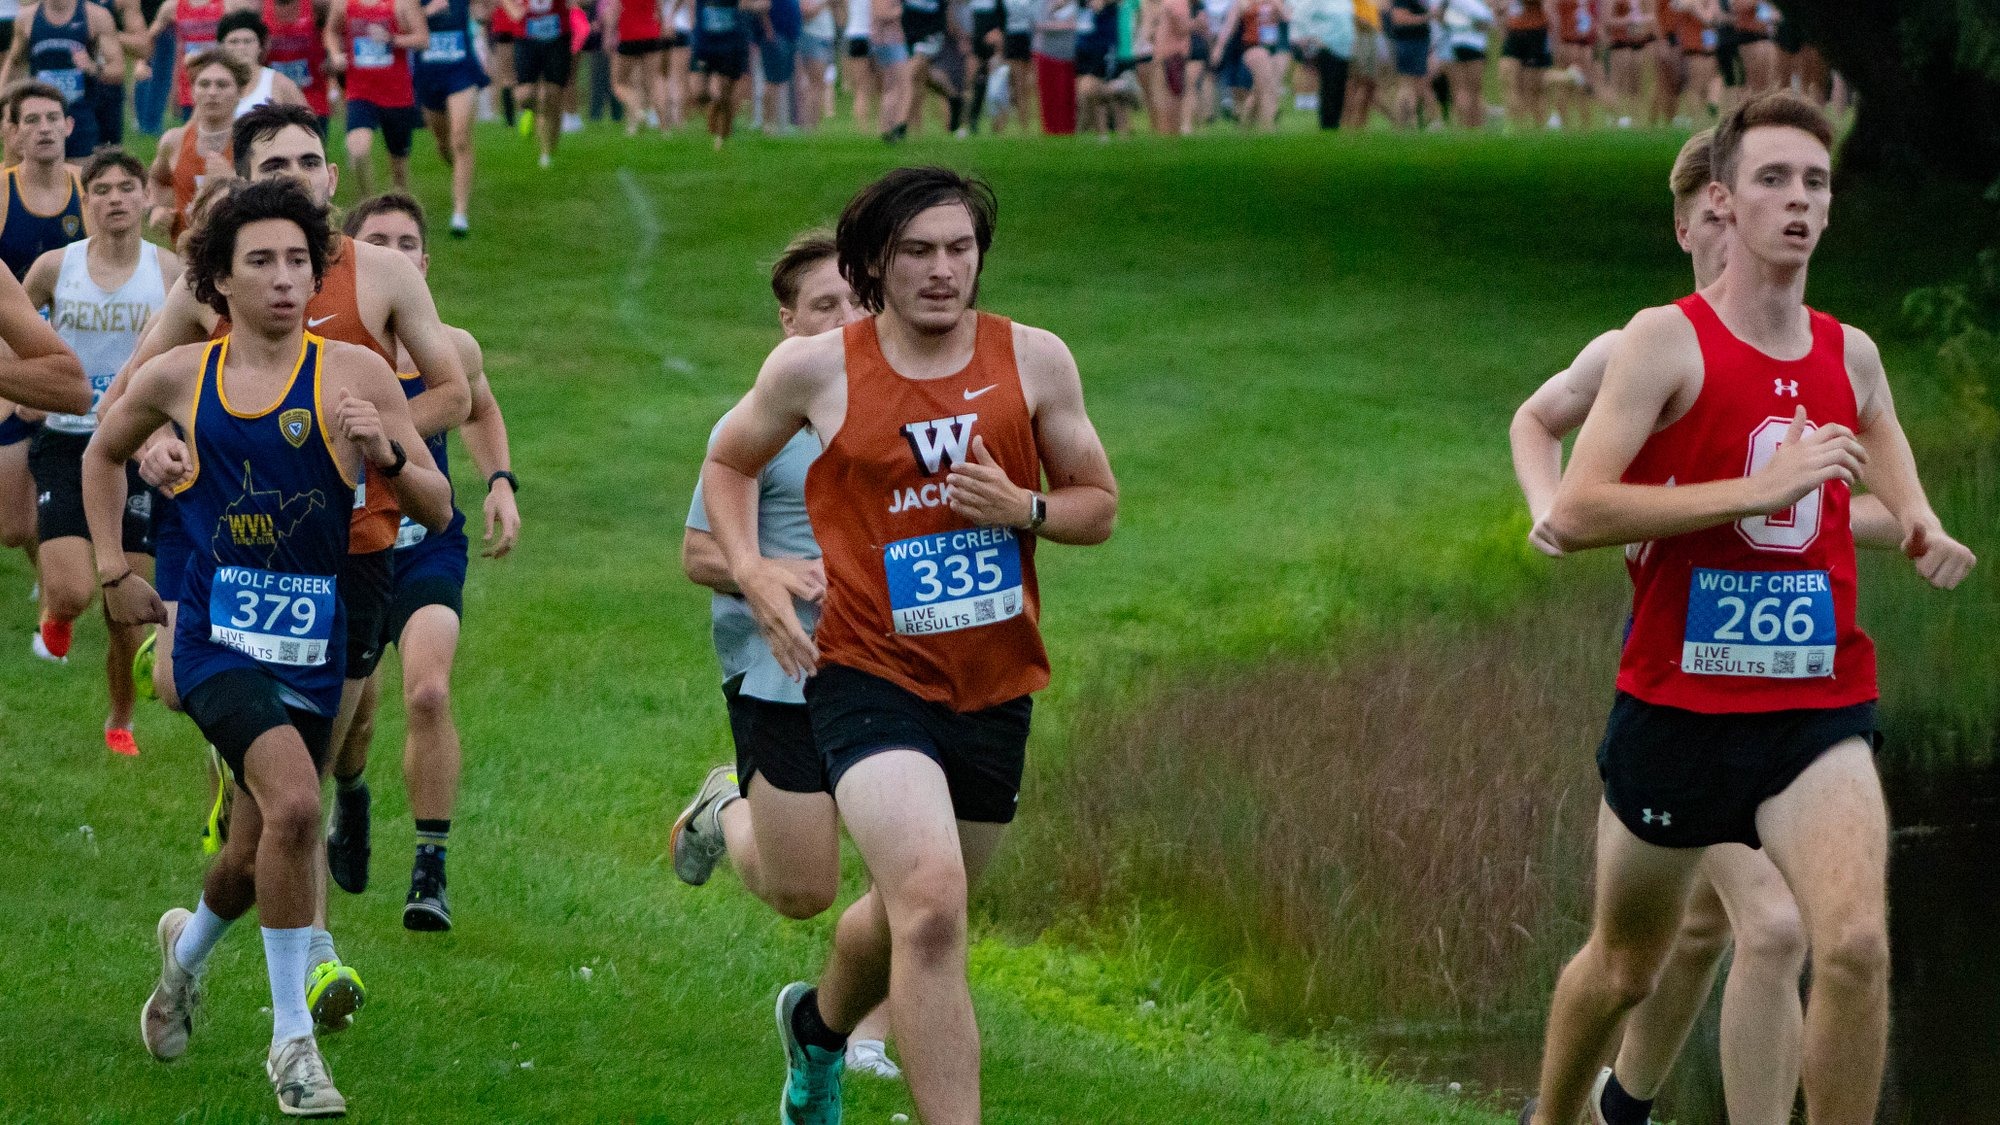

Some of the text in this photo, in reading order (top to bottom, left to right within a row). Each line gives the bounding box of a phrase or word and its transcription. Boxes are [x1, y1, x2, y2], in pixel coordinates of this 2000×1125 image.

[903, 413, 978, 475] W
[890, 526, 1014, 561] WOLF CREEK
[220, 568, 332, 595] WOLF CREEK
[912, 548, 1003, 602] 335
[1699, 572, 1828, 593] WOLF CREEK
[230, 590, 316, 635] 379
[904, 607, 936, 622] LIVE
[905, 613, 970, 633] RESULTS
[1713, 596, 1815, 642] 266
[219, 628, 245, 643] LIVE
[1694, 646, 1731, 659] LIVE
[1693, 659, 1765, 673] RESULTS
